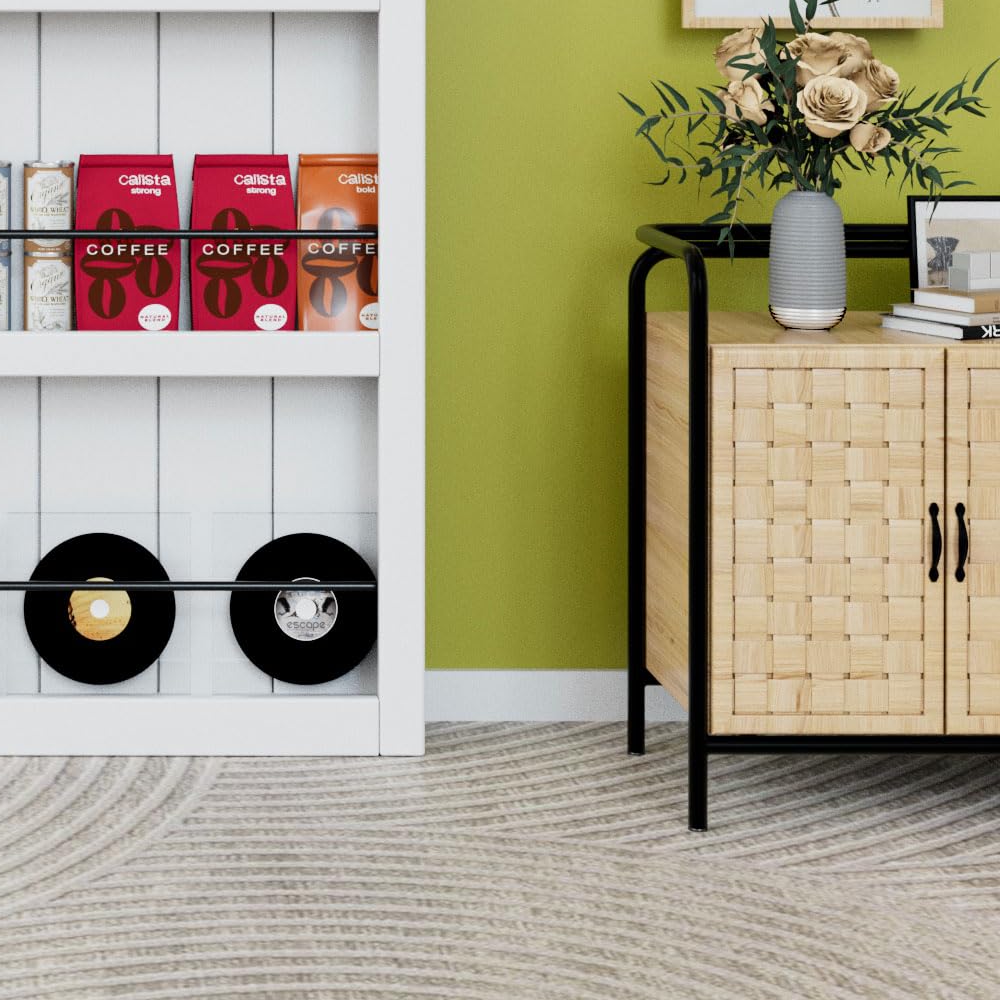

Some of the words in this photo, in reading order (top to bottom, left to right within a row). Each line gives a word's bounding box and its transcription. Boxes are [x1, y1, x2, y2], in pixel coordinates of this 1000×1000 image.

[130, 187, 162, 196] strong
[246, 187, 276, 196] strong
[86, 244, 168, 256] COFFEE
[202, 243, 284, 256] COFFEE
[308, 242, 376, 254] COFFE
[286, 622, 326, 631] escape
